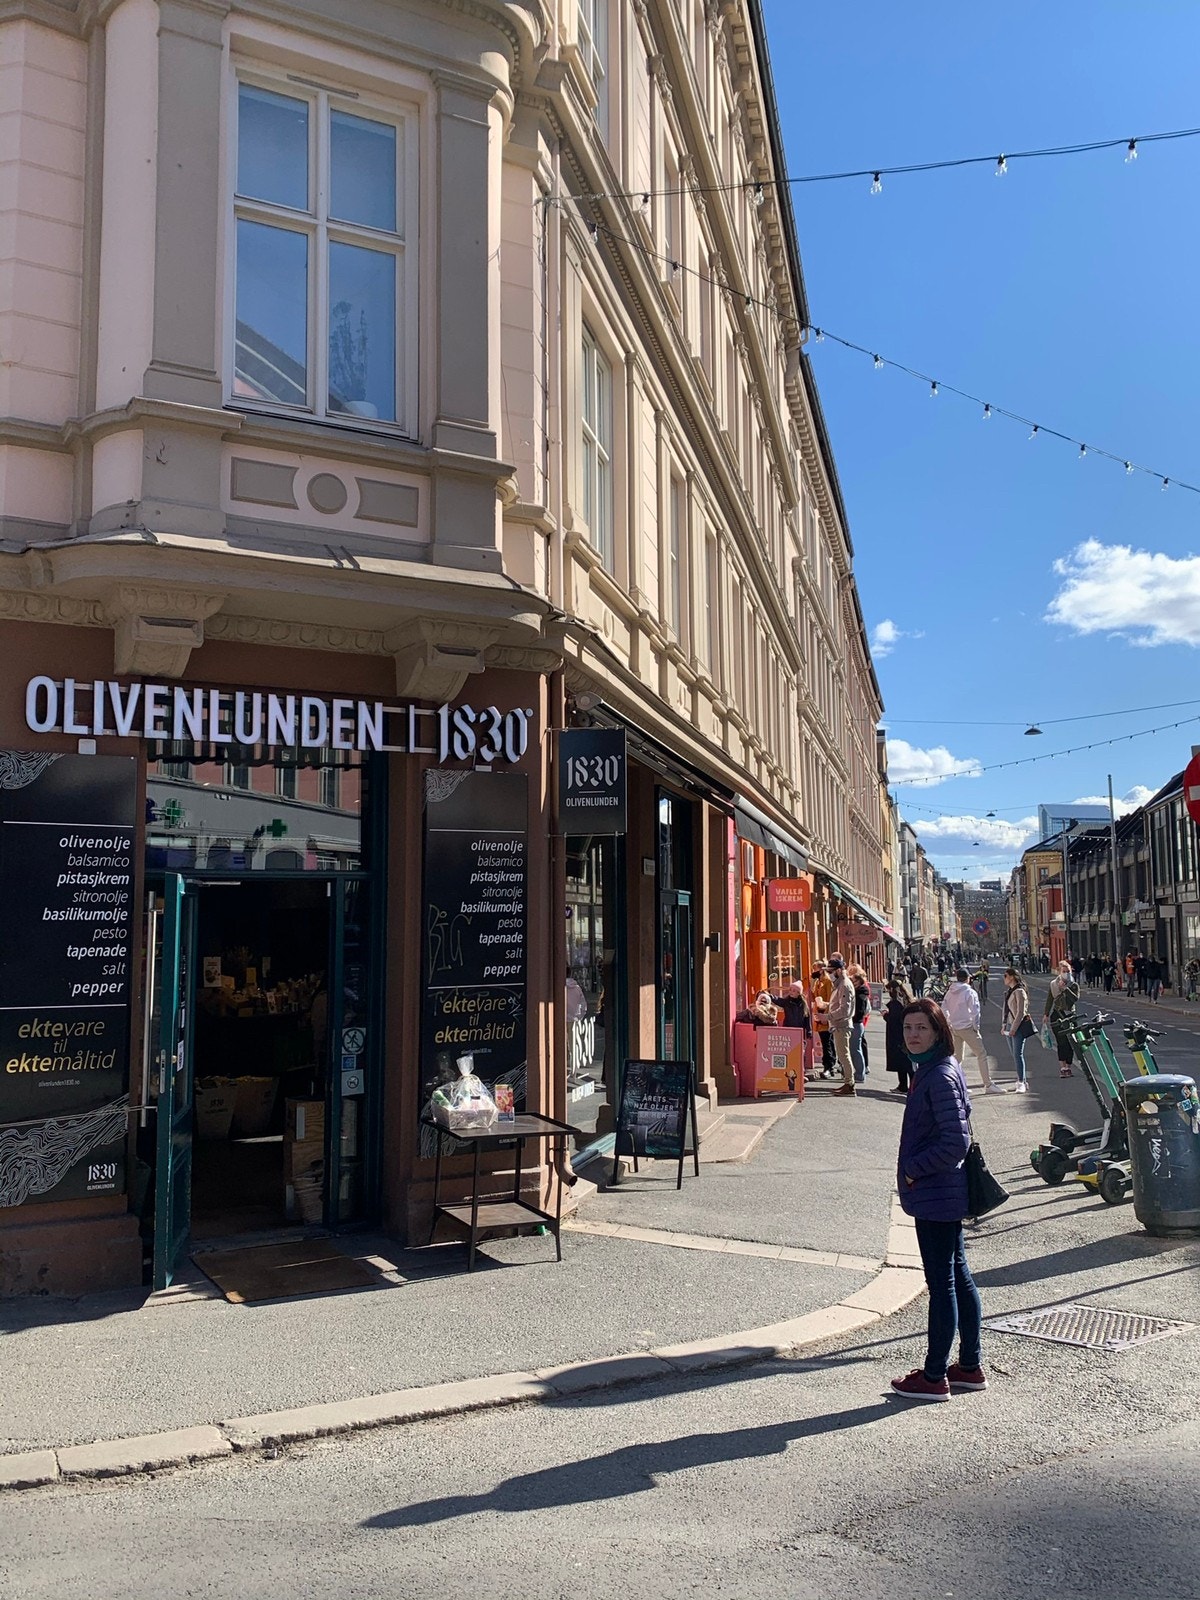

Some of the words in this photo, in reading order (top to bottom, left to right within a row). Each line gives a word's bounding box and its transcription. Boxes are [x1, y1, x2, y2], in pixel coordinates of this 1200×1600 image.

[24, 675, 384, 752] OLIVENLUNDEN
[565, 797, 619, 807] OLIVENLUNDEN
[59, 835, 131, 852] olivenolje
[471, 839, 524, 854] olivenolje
[67, 852, 130, 868] balsamico
[477, 854, 523, 867] balsamico
[56, 871, 130, 887] pistasjkrem
[470, 870, 524, 885] pistasjkrem
[72, 889, 128, 905] sitronolje
[482, 885, 523, 899] sitronolje
[42, 907, 128, 924] basilikumolje
[461, 901, 523, 916] basilikumolje
[497, 916, 523, 930] pesto
[92, 926, 127, 941] pesto
[478, 932, 523, 946] tapenade
[67, 944, 126, 960] tapenade
[505, 947, 522, 959] salt
[102, 962, 126, 975] salt
[484, 964, 521, 978] pepper
[71, 982, 124, 997] pepper
[442, 995, 507, 1013] ektevare
[469, 1013, 480, 1026] til
[18, 1017, 105, 1040] ektevare
[434, 1022, 516, 1043] ektemåltid
[53, 1038, 68, 1054] til
[6, 1048, 116, 1074] ektemåltid
[642, 1094, 667, 1103] ÅRETS
[87, 1183, 115, 1191] OLIVENLUNDEN
